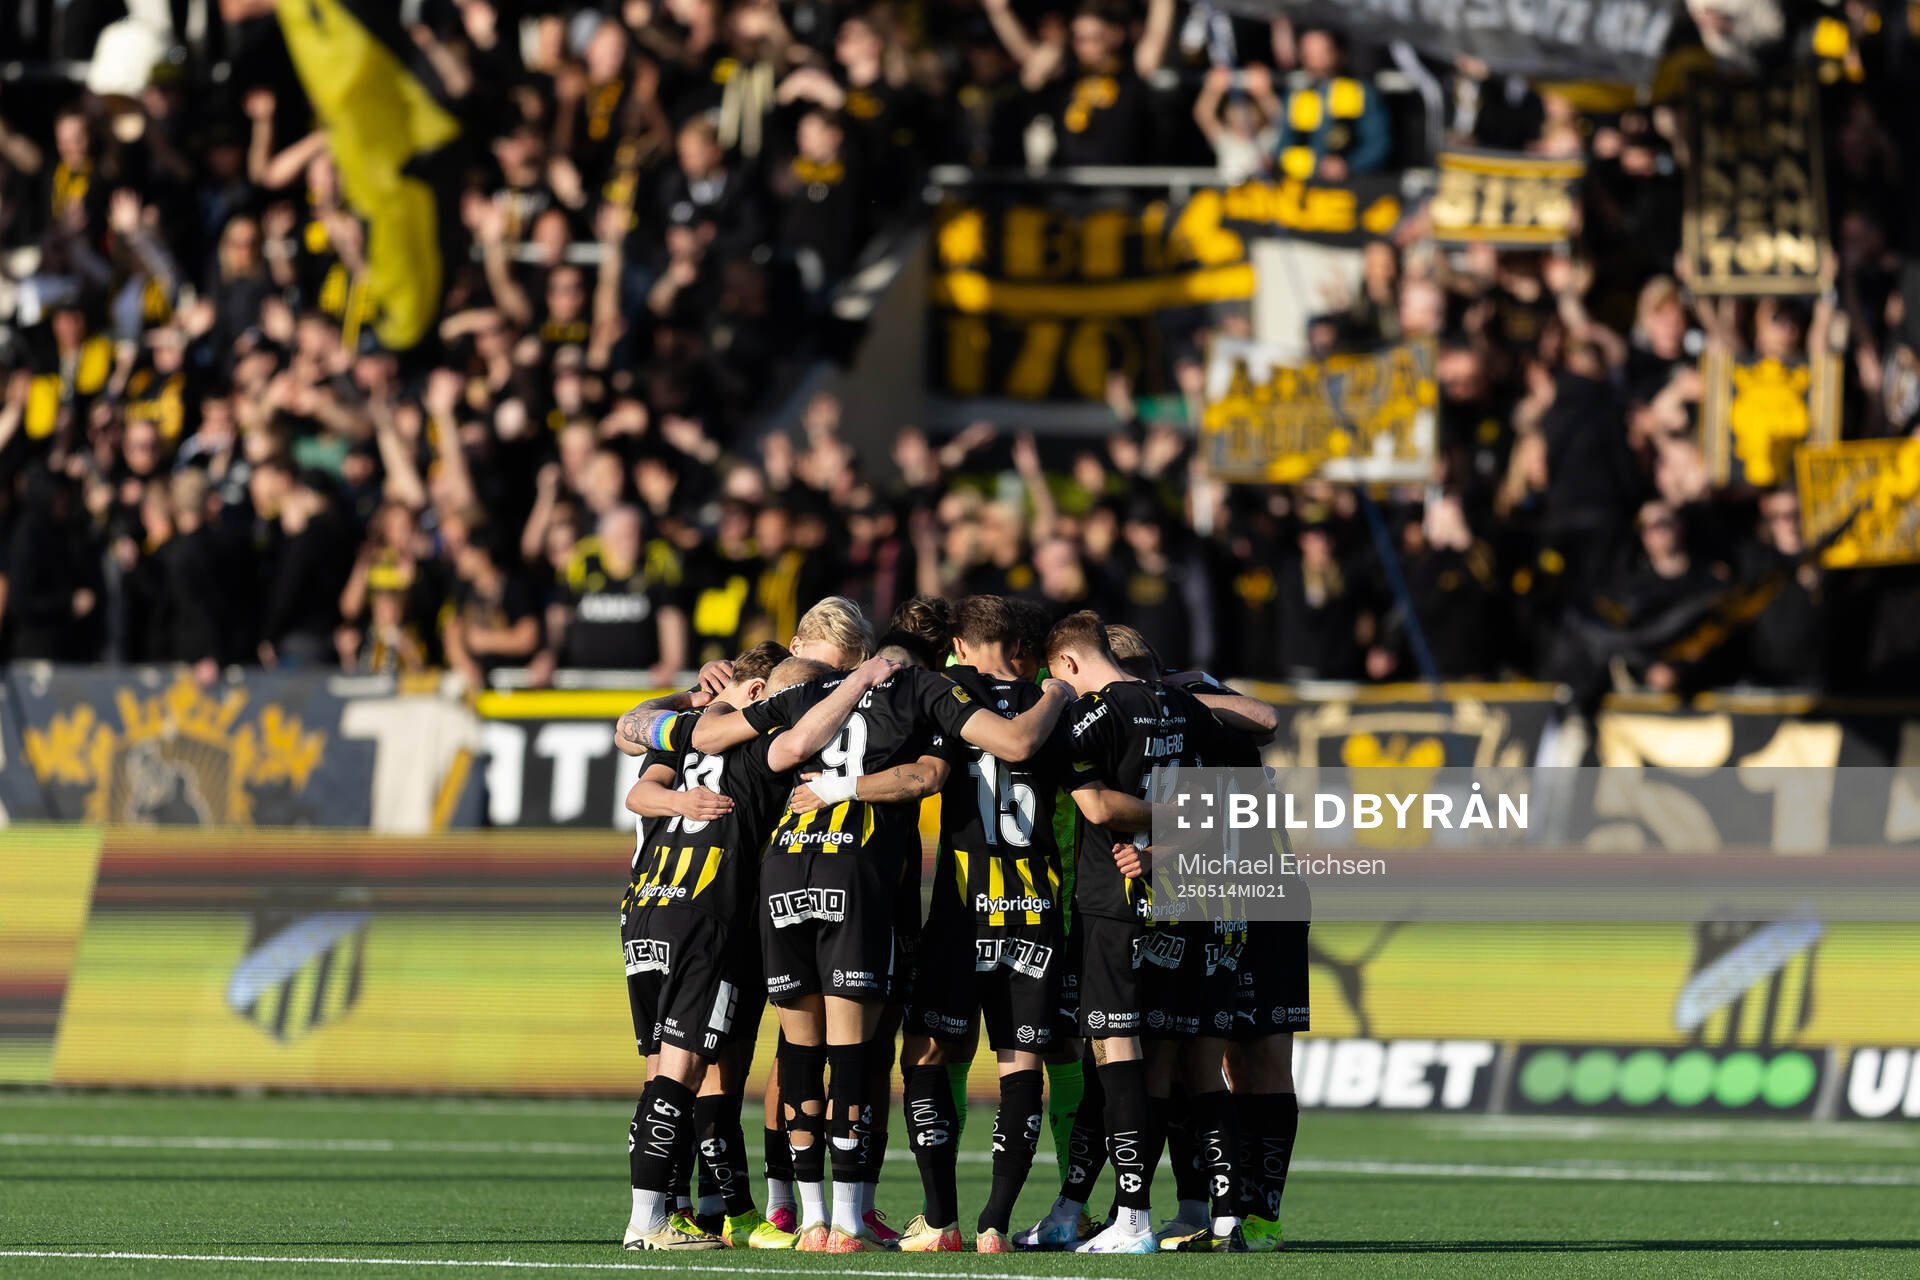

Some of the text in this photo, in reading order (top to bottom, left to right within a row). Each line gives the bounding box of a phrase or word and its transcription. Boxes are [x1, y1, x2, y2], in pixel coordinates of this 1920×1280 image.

[1072, 703, 1108, 738] stadium
[821, 711, 868, 778] 9
[968, 751, 1036, 848] 15
[779, 830, 853, 846] Hybridge
[976, 893, 1051, 914] Hybridge
[703, 1032, 718, 1050] 10
[1293, 1037, 1497, 1109] IBET
[1114, 1130, 1144, 1171] JOVI
